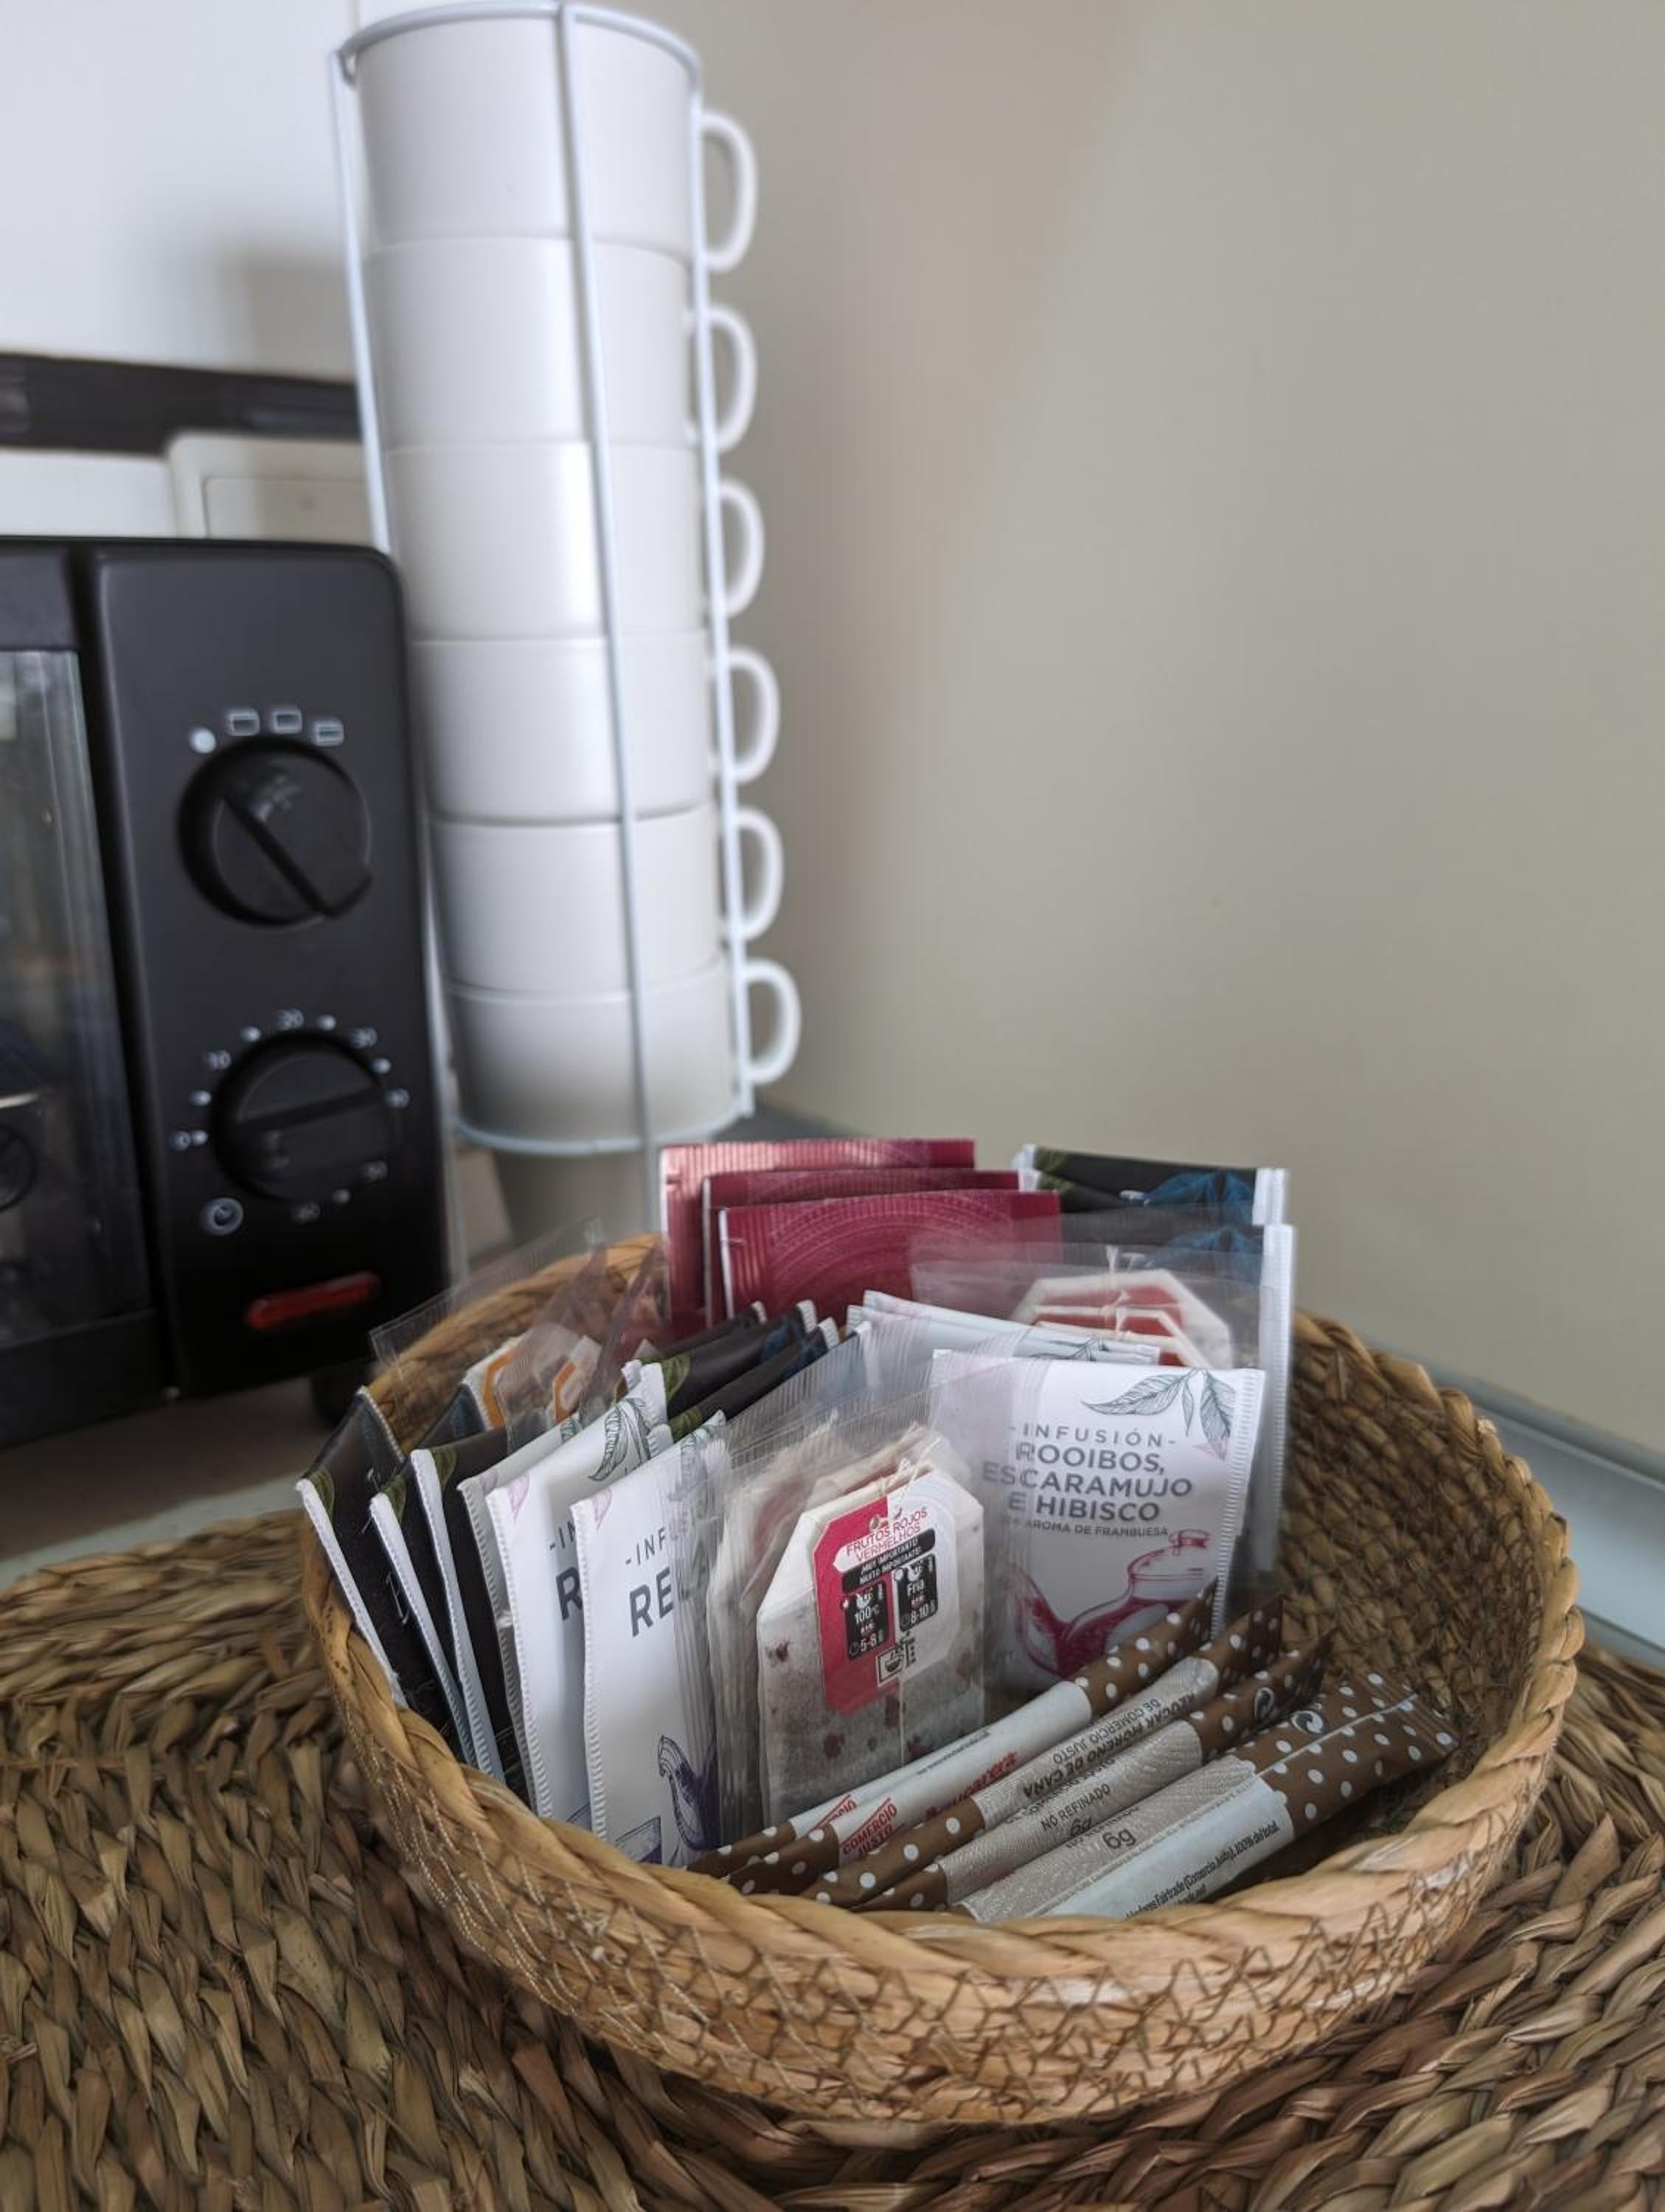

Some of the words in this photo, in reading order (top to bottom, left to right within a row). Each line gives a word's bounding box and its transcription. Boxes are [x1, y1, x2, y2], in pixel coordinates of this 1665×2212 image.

[1015, 1441, 1165, 1475] ROOIBOS,
[981, 1461, 1192, 1498] ESCARAMUJO
[1007, 1492, 1026, 1512] E
[1035, 1494, 1160, 1523] HIBISCO
[846, 1528, 890, 1556] FRUTOS
[893, 1507, 928, 1531] ROJOS
[855, 1523, 921, 1562] VERMELHOS
[1074, 1523, 1092, 1535] DE
[1089, 1707, 1144, 1743] COMERCIO
[1052, 1737, 1088, 1765] JUSTO
[1040, 1815, 1059, 1832] NO
[1058, 1783, 1110, 1820] REFINADO
[841, 1803, 897, 1855] COMERCIO
[1102, 1828, 1137, 1850] 6g
